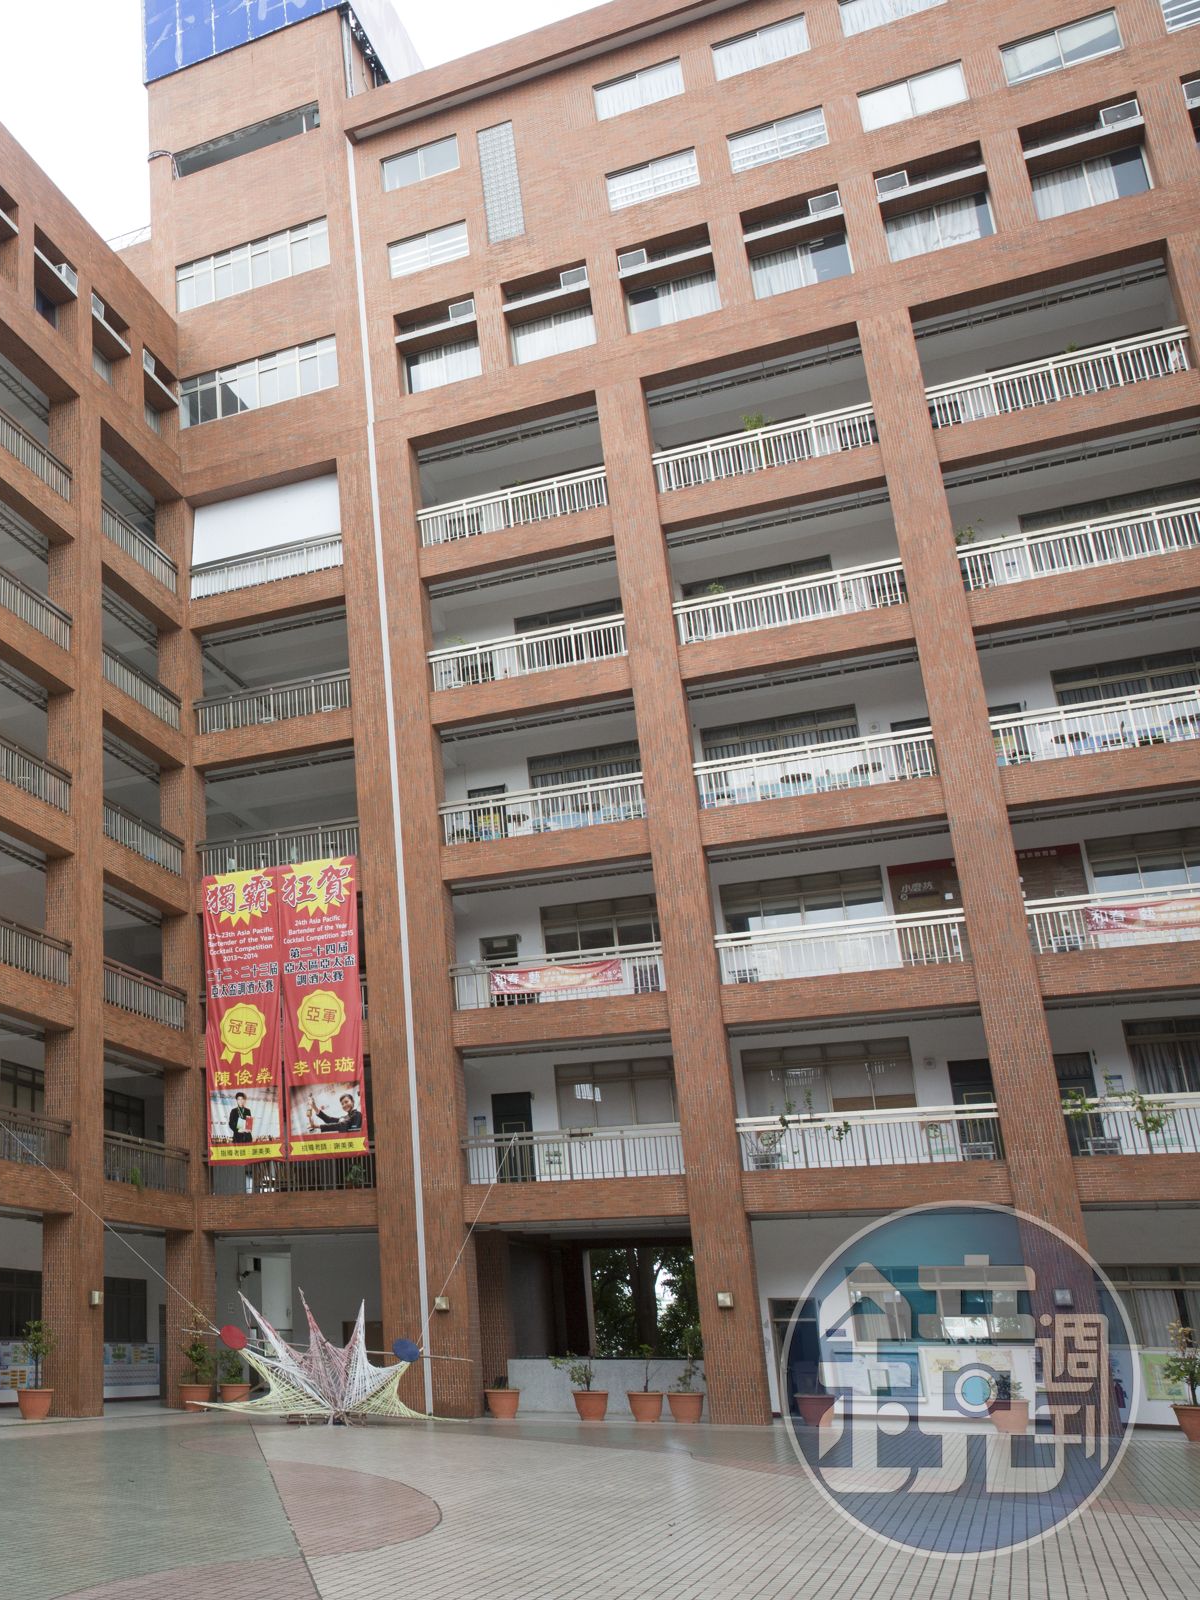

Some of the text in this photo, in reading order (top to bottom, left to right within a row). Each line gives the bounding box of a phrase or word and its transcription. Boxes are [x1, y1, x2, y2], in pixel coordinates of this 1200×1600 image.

[281, 864, 351, 908] 狂賀
[252, 926, 273, 934] Pacific
[284, 936, 305, 944] Cocktail
[306, 933, 339, 941] Competition
[288, 927, 316, 935] Bartender
[209, 944, 273, 956] Cocktail Competition
[284, 954, 356, 974] 亞太區亞太盃
[296, 970, 344, 986] 調酒大賽
[306, 1005, 337, 1024] 亞軍
[228, 1018, 258, 1037] 冠軍
[292, 1057, 356, 1077] 李怡璇
